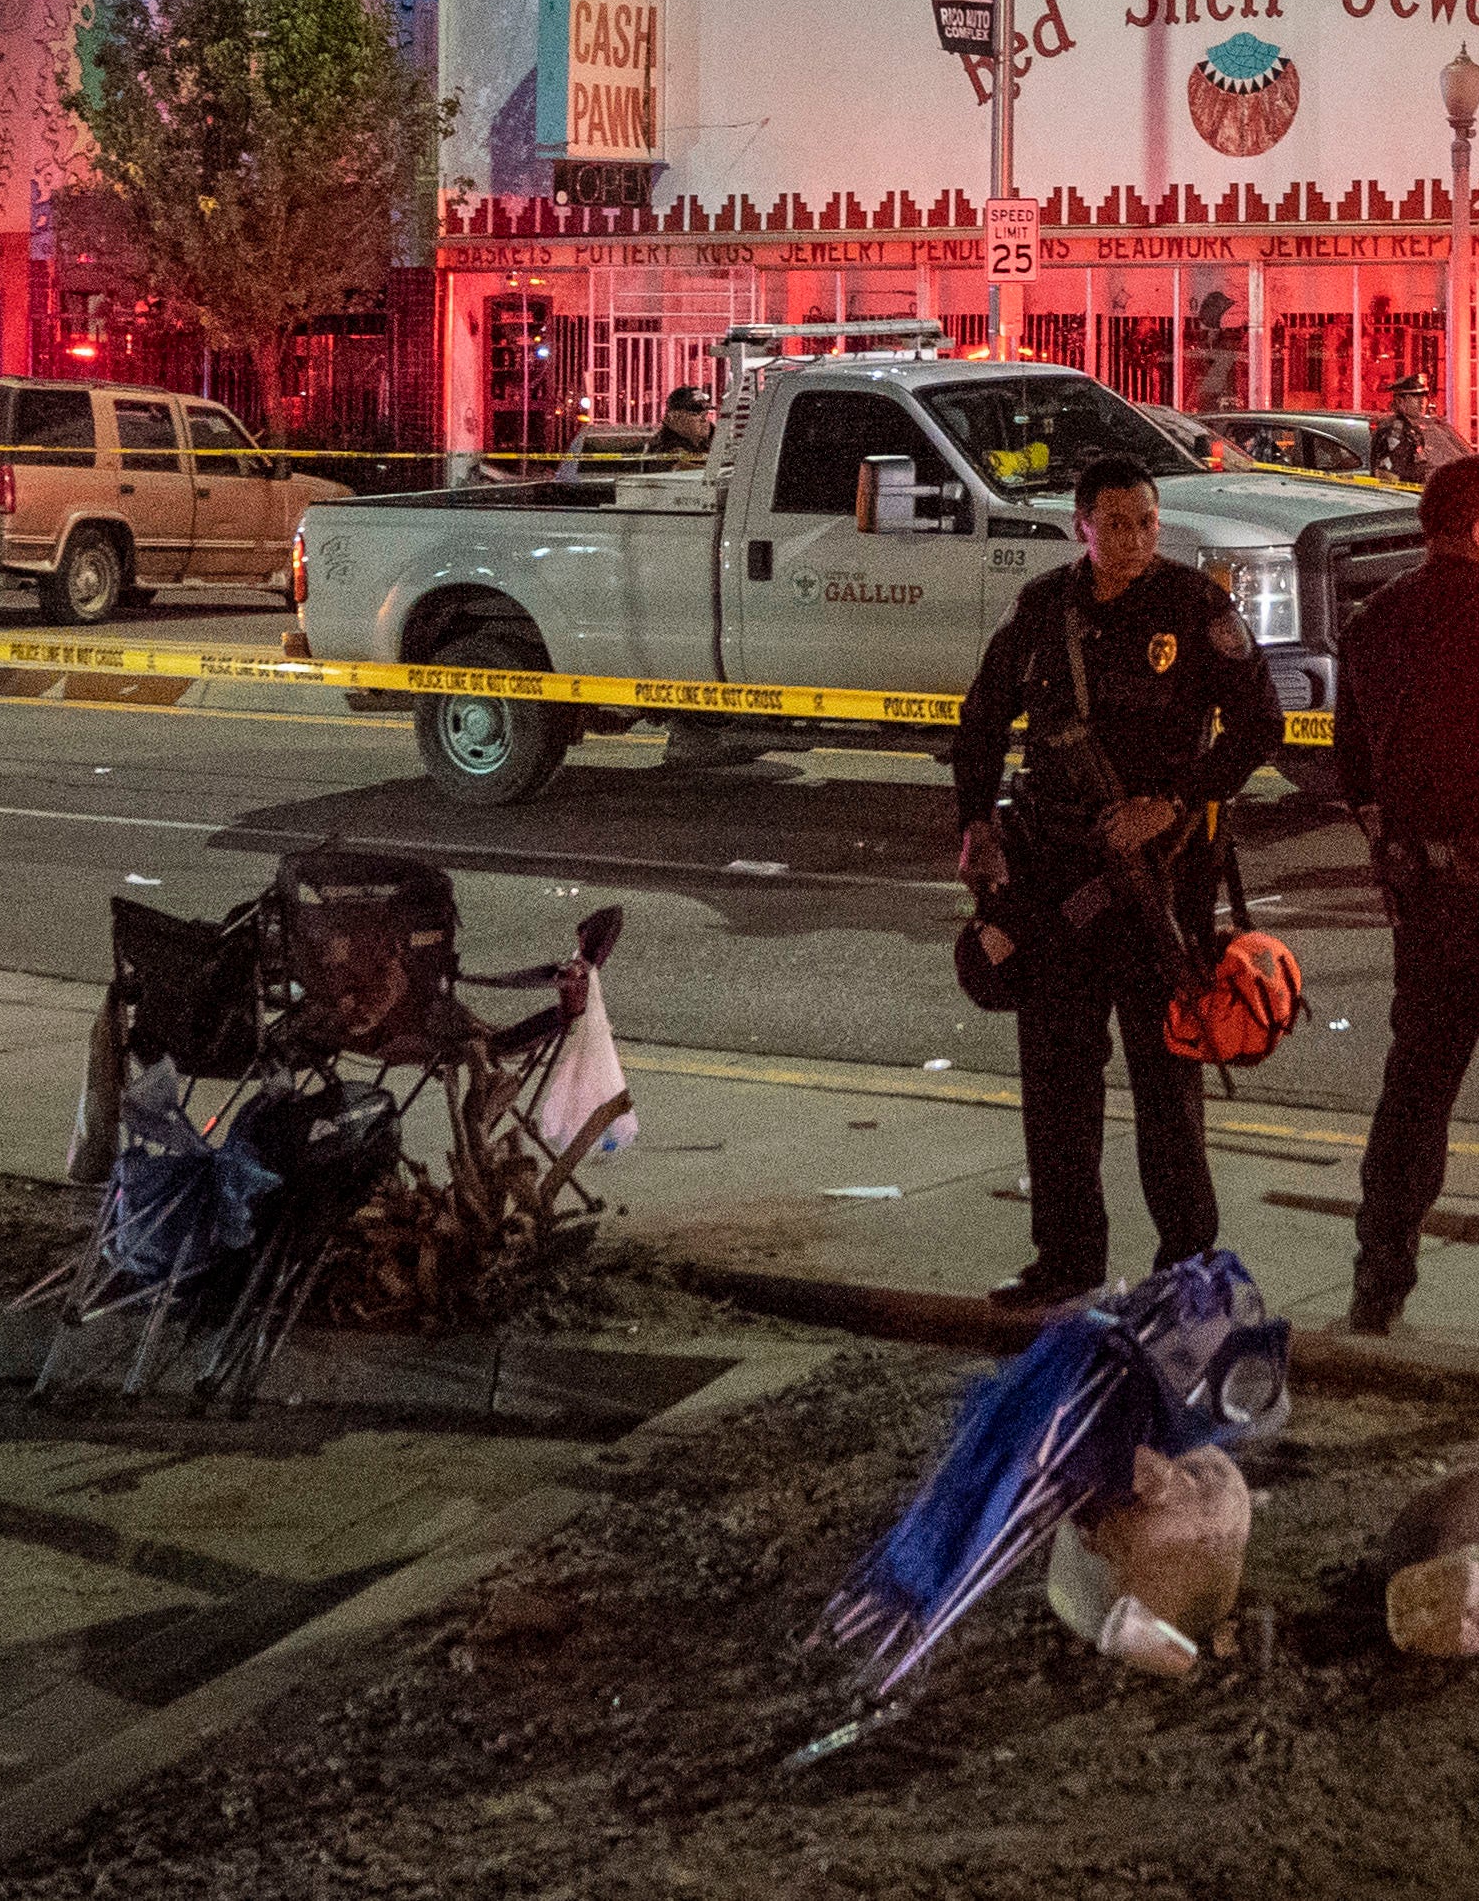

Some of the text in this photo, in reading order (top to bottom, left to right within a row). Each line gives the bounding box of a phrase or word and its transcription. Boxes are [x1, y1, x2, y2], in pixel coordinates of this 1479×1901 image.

[965, 9, 991, 29] AUTO
[574, 0, 657, 69] CASH
[944, 26, 991, 42] COMPLEX
[573, 81, 657, 149] PAWN
[990, 208, 1034, 222] SPEED
[994, 226, 1029, 239] LIMIT
[457, 245, 552, 265] BASKETS
[574, 244, 672, 264] POTTERY
[695, 244, 755, 265] RUGS
[779, 241, 885, 263] JEWELRY
[1097, 235, 1235, 260] BEADWORK
[1259, 235, 1380, 258] JEWELRY
[992, 244, 1033, 274] 25
[992, 548, 1026, 566] 803
[824, 582, 925, 605] GALLUP
[408, 668, 444, 689] POLICE
[445, 671, 468, 690] LINE
[487, 673, 508, 693] NOT
[509, 674, 544, 696] CROSS
[635, 682, 783, 709] POLICE LINE DO NOT CROSS
[883, 696, 955, 721] POLICE LINE
[1291, 717, 1334, 741] CROSS
